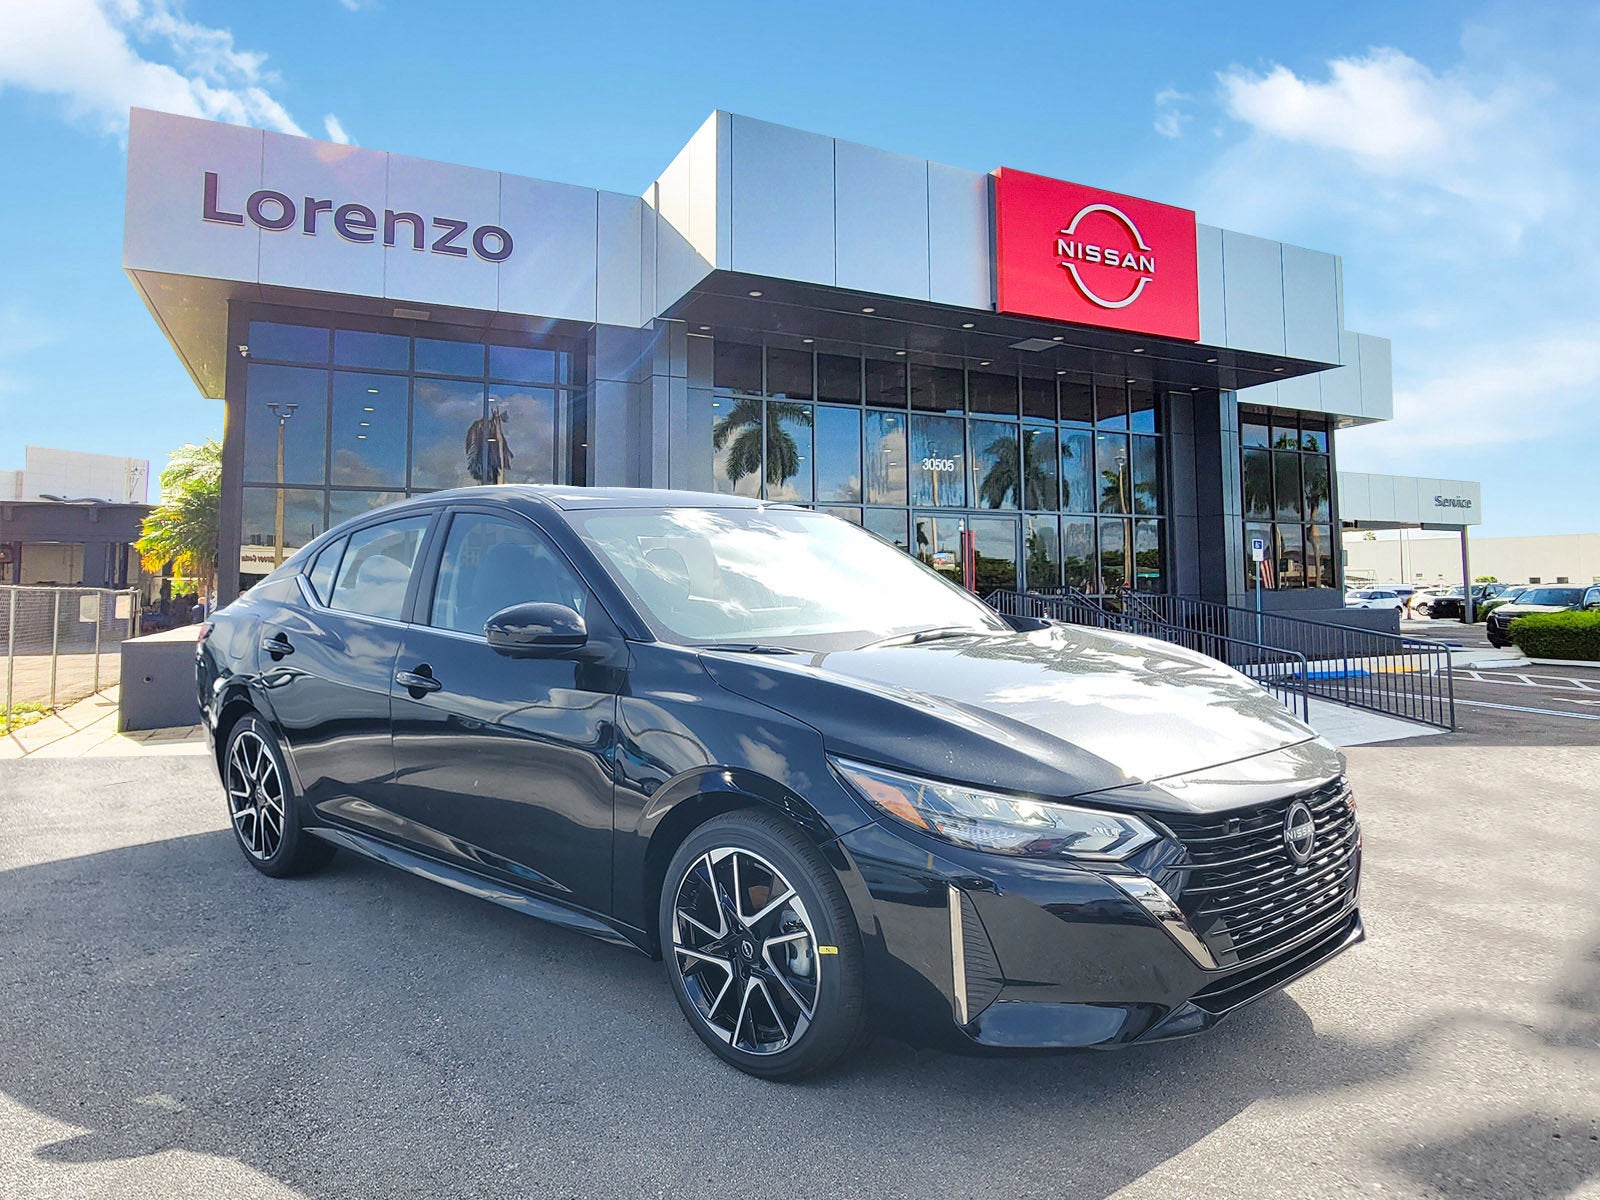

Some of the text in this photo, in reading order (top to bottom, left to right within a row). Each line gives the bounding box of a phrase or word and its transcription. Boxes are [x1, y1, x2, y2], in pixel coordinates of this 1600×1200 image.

[202, 171, 514, 262] Lorenzo
[1057, 238, 1155, 273] NISSAN
[922, 458, 955, 472] 30505
[1434, 495, 1472, 509] Service
